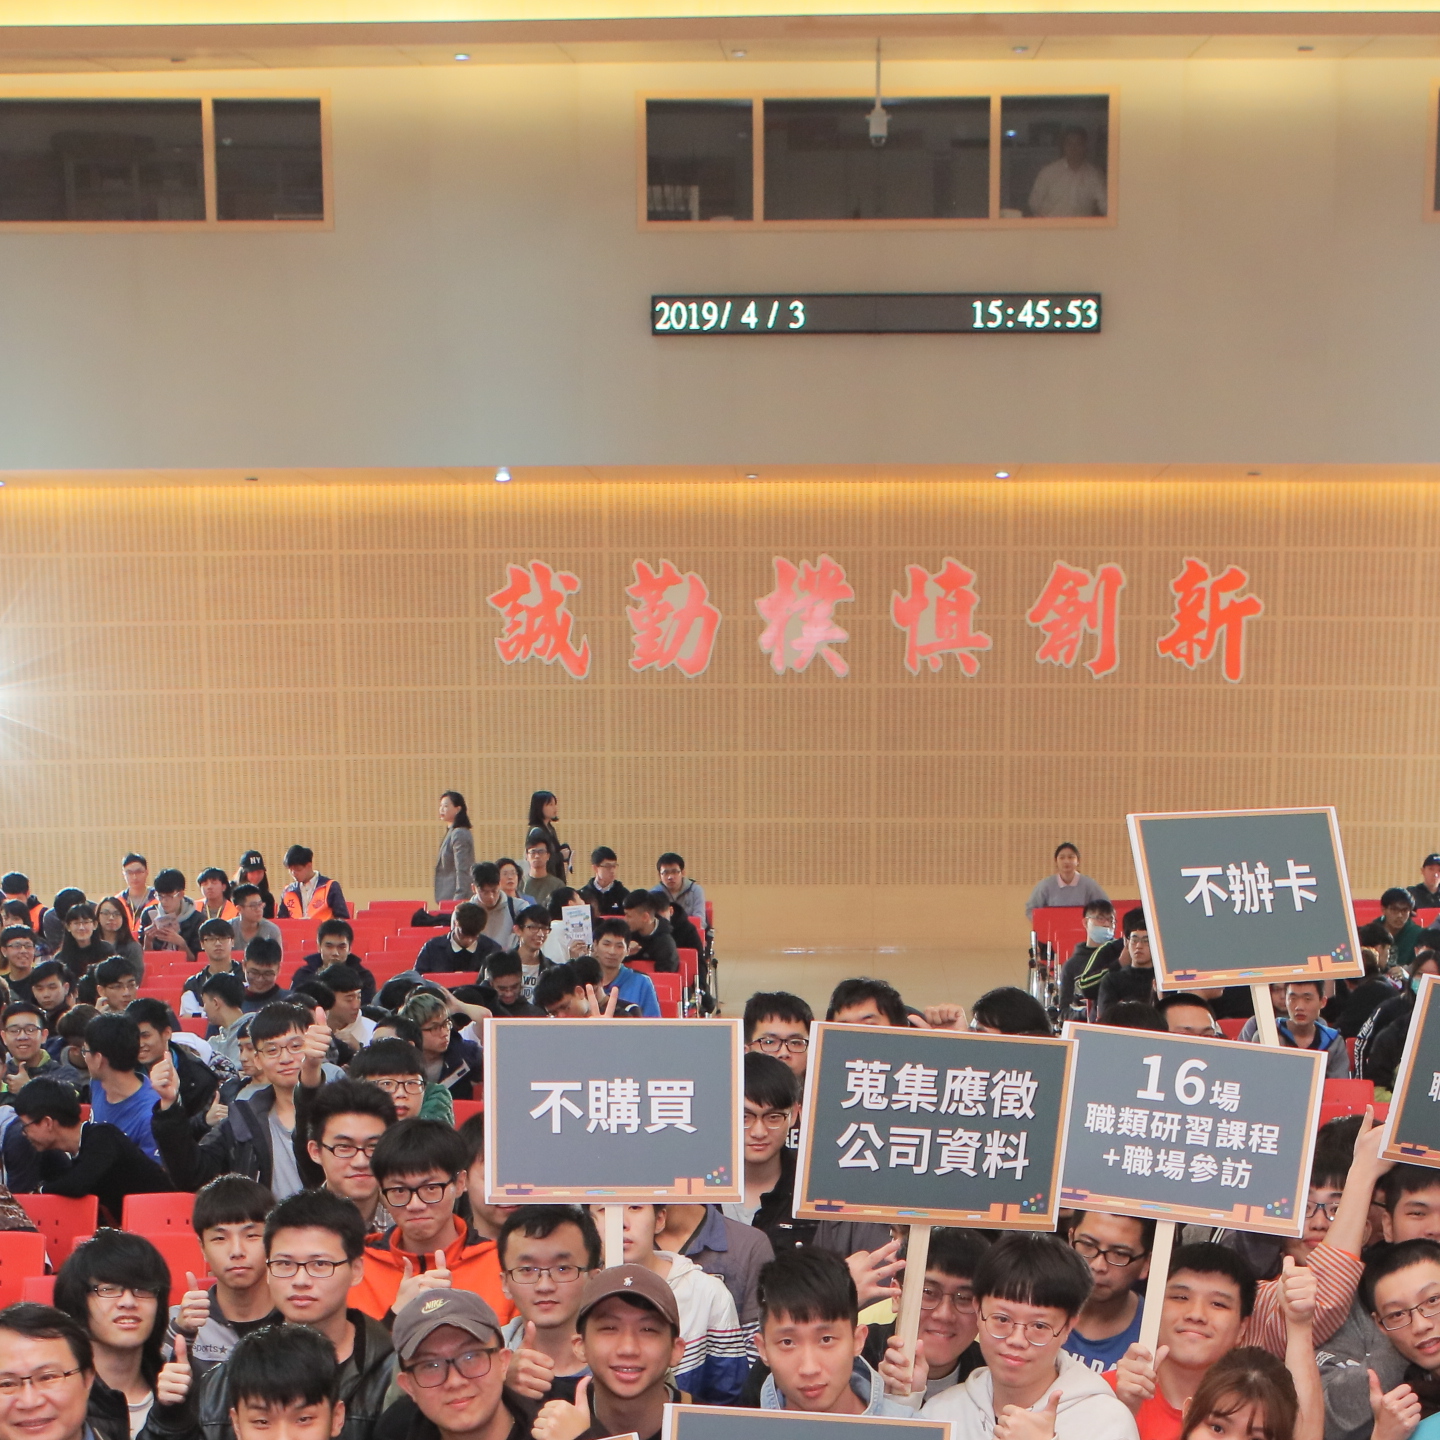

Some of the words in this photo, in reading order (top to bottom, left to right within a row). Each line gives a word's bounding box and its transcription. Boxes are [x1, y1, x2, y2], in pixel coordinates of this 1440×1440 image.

[972, 299, 1099, 329] 15:45:53
[488, 555, 1262, 681] 誠勤樸慎創新
[1180, 858, 1318, 920] 不辦卡
[529, 1080, 696, 1135] 不購買
[840, 1059, 1039, 1121] 蒐集應徵
[1135, 1054, 1242, 1114] 16場
[837, 1123, 1030, 1181] 公司資料
[1084, 1102, 1281, 1156] 職類研習課程
[1103, 1143, 1253, 1190] +職場參訪
[426, 1299, 443, 1310] NIKE
